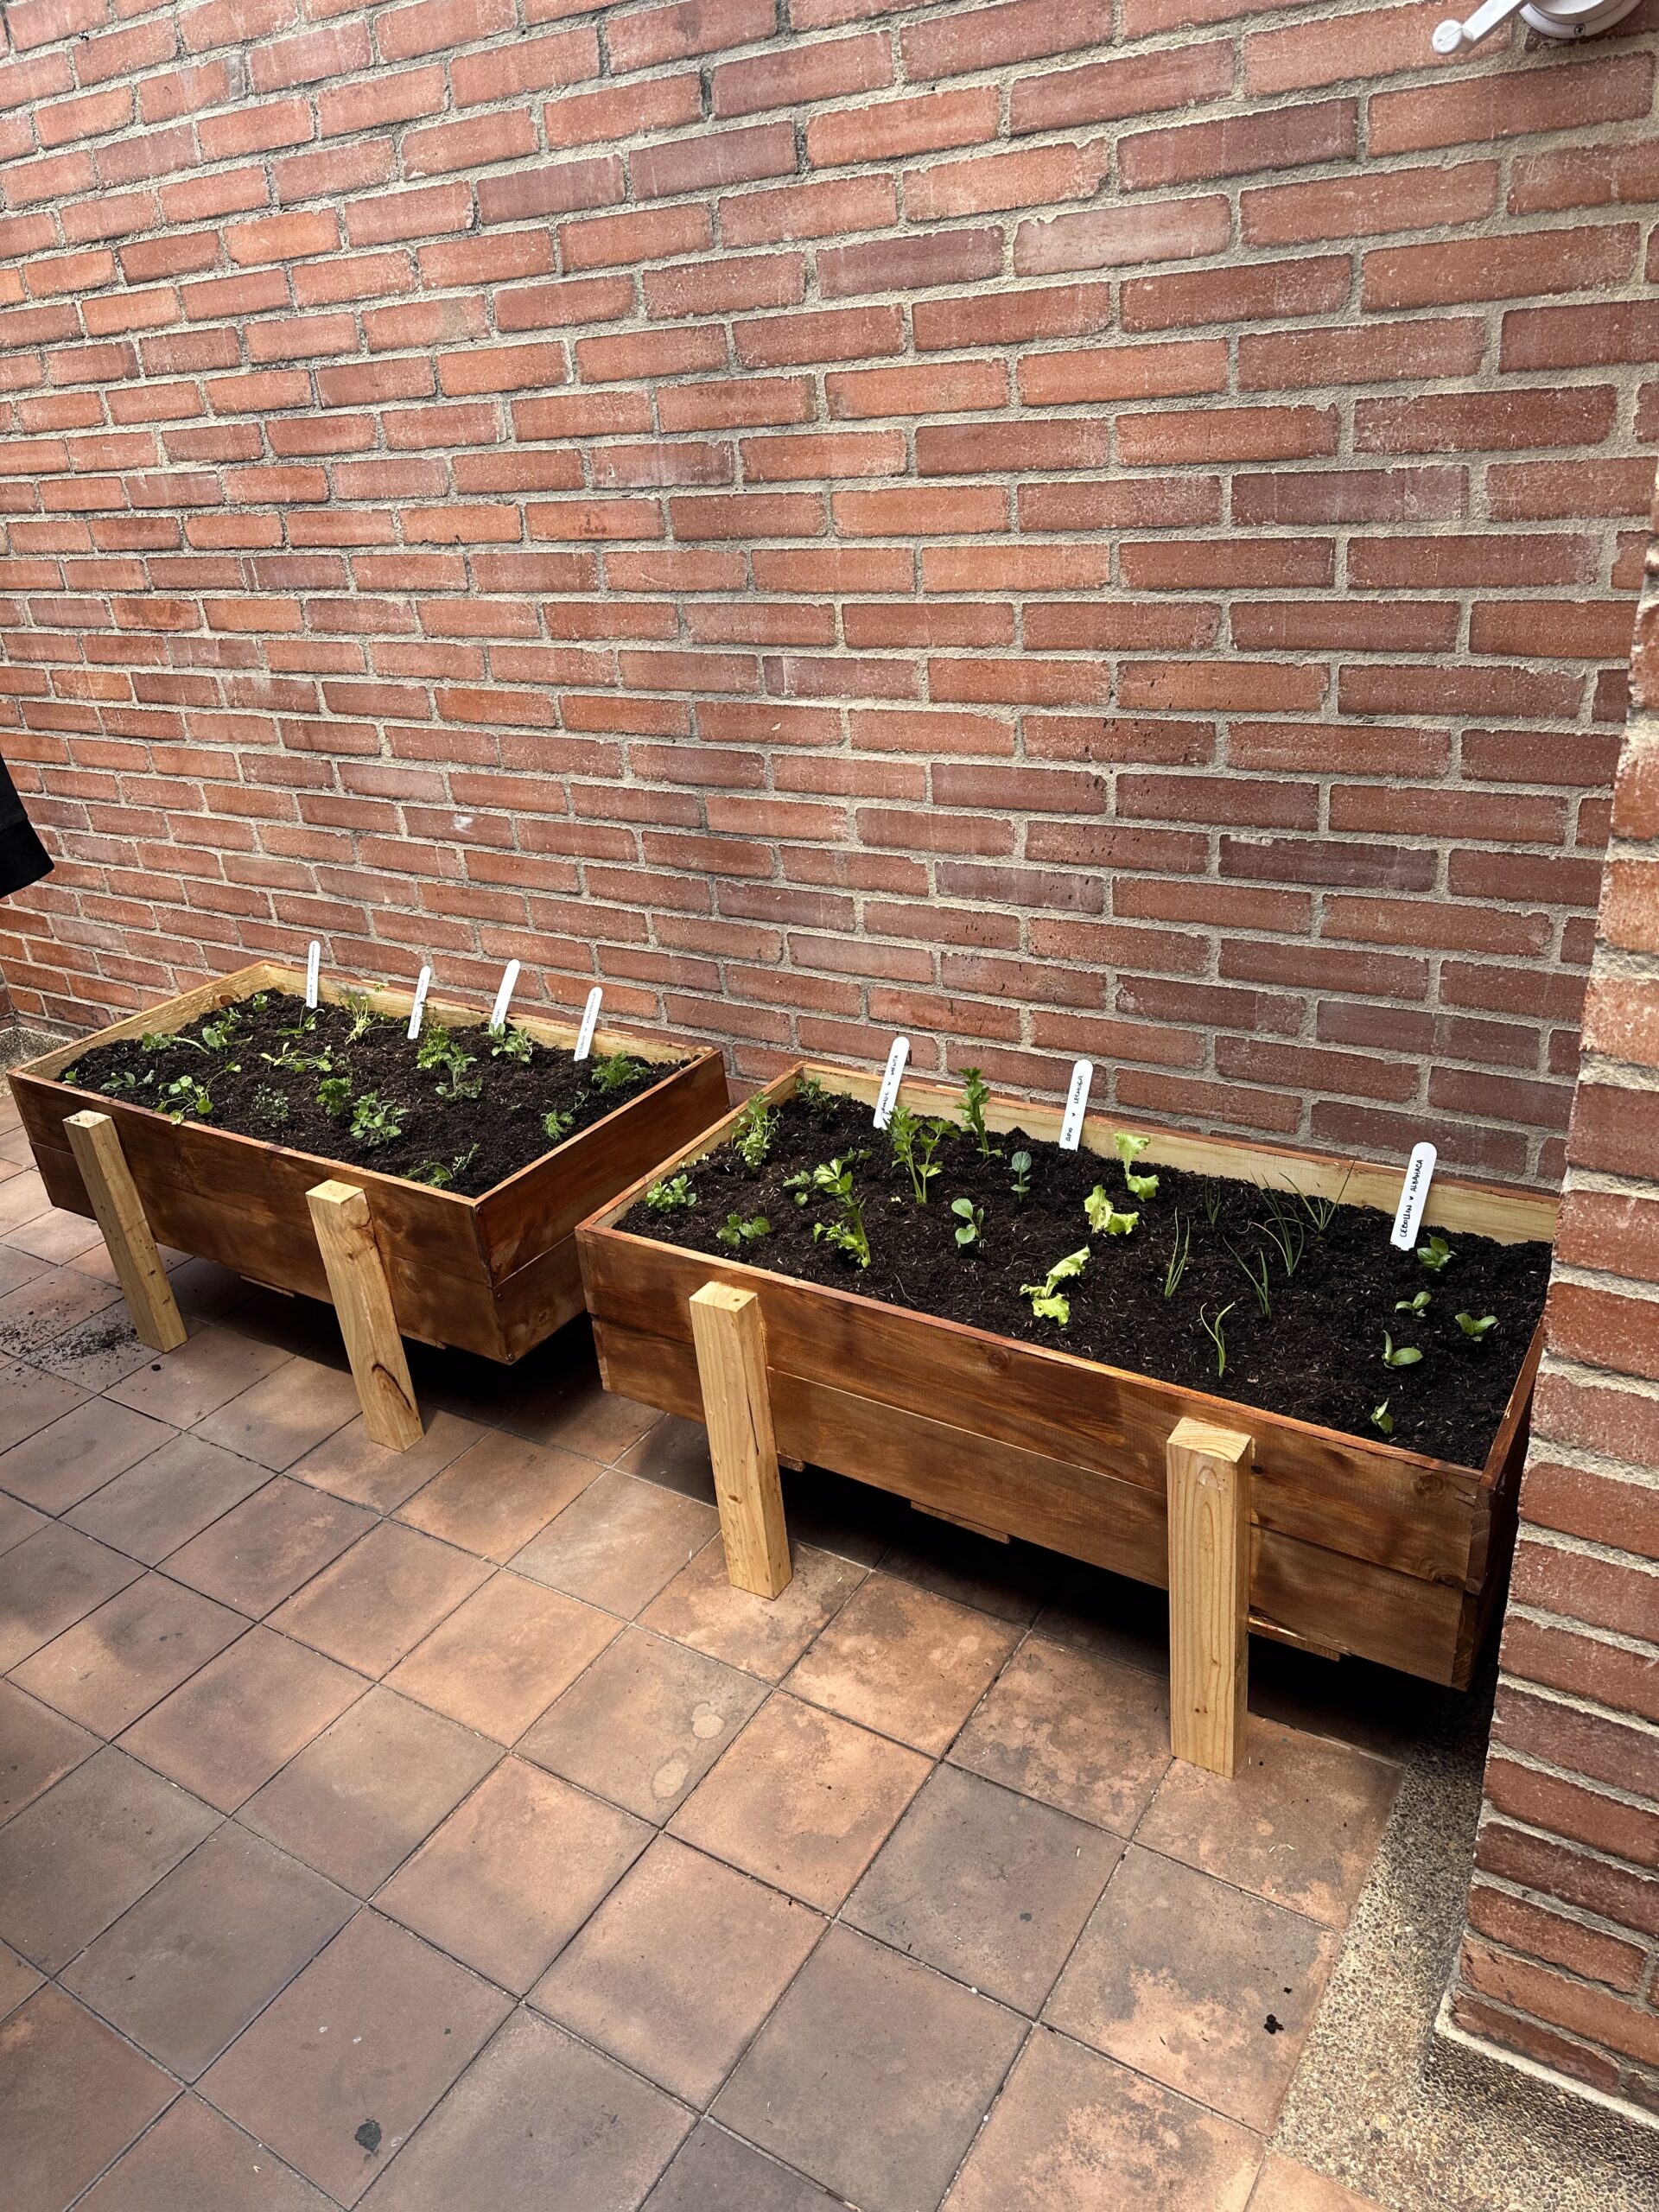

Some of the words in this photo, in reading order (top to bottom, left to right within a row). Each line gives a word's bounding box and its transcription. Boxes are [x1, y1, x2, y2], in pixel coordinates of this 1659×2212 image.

[1074, 1076, 1084, 1103] LECHUGA
[1400, 1205, 1412, 1237] CEBOLLIN
[1410, 1160, 1423, 1192] ALBAHACA
